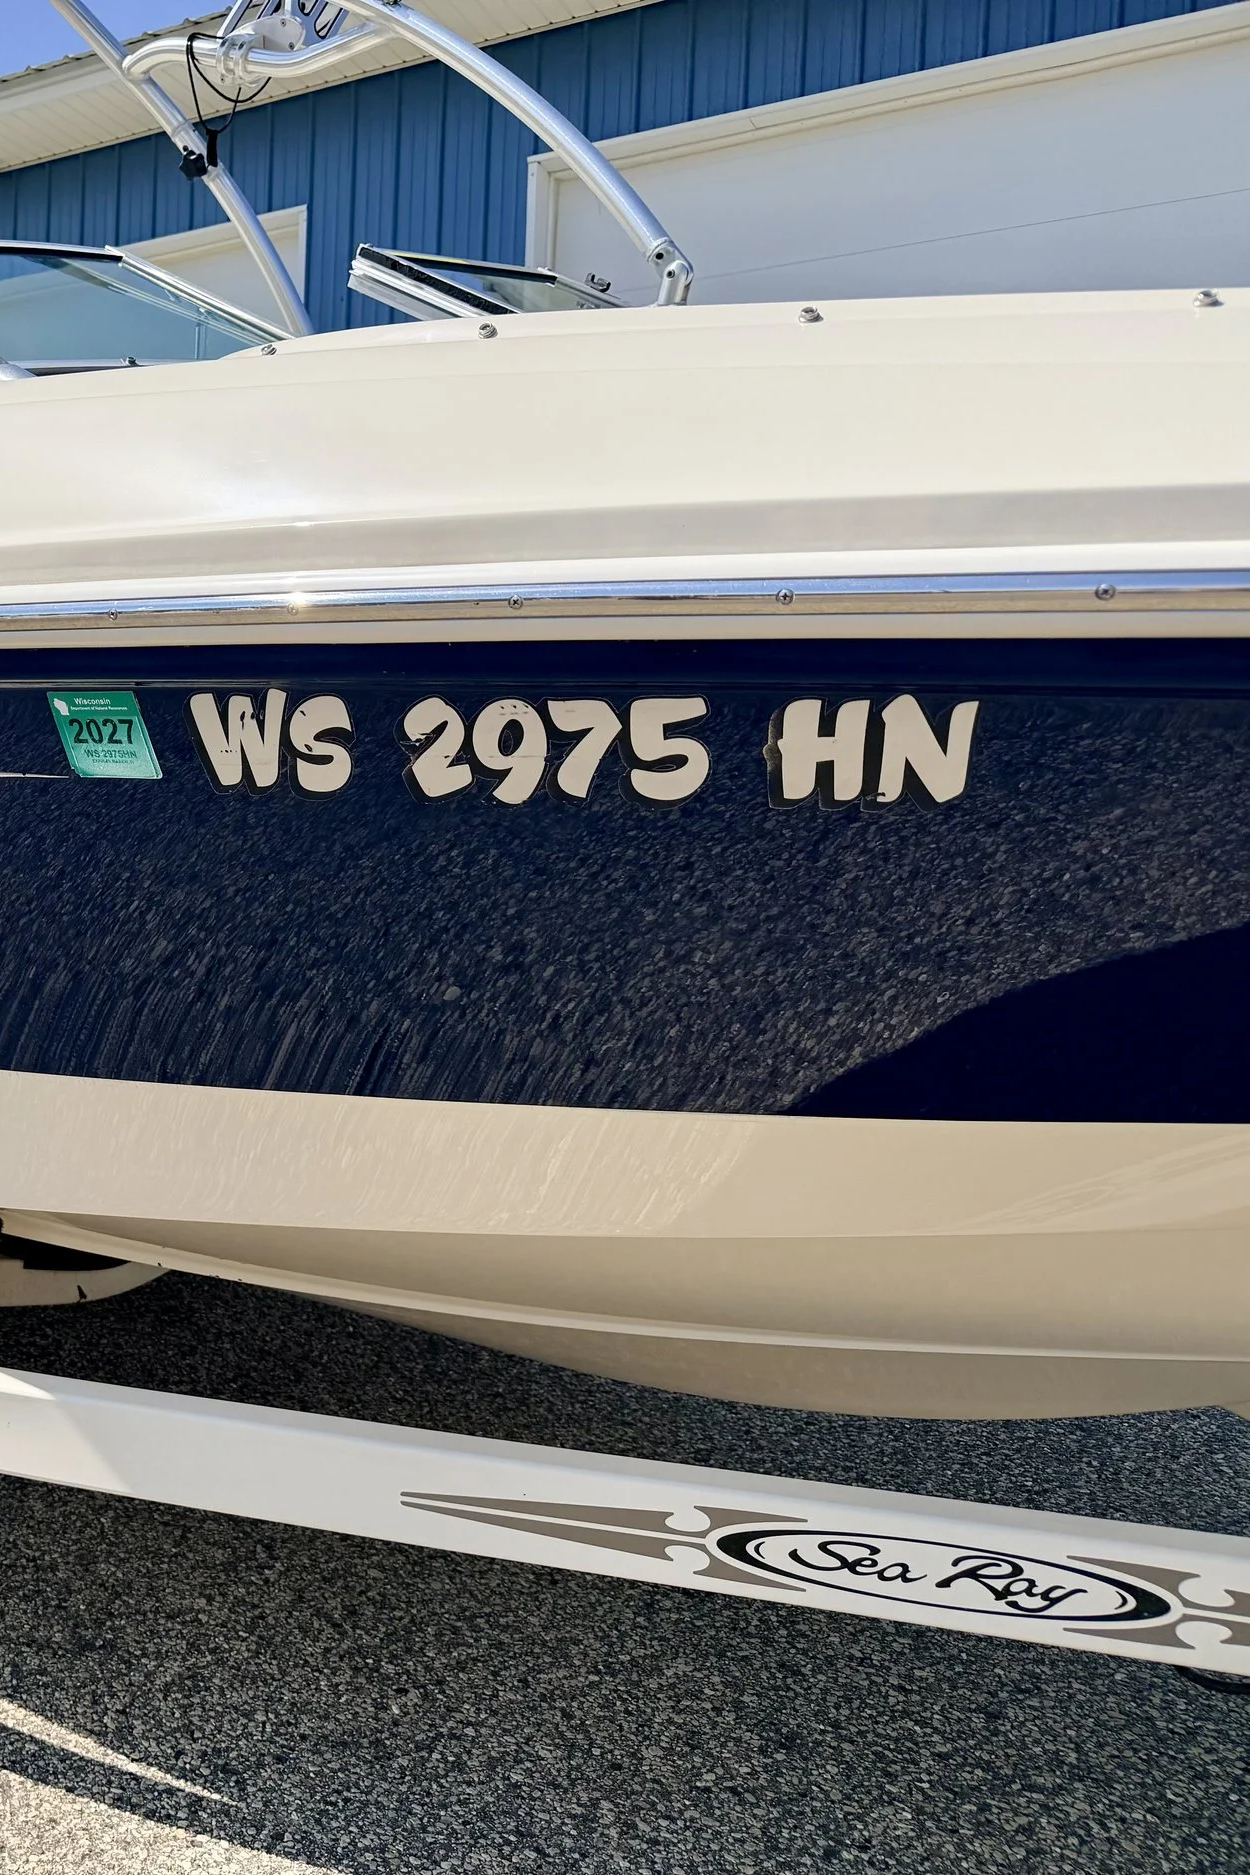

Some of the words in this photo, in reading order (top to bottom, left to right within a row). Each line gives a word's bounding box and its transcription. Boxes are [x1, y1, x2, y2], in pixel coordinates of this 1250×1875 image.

[73, 697, 111, 705] Wisconsin
[68, 718, 134, 745] 2027
[186, 687, 354, 798] WS
[397, 695, 711, 806] 2975
[769, 693, 980, 808] HN
[787, 1539, 928, 1584] Sea
[934, 1554, 1088, 1612] Ray
